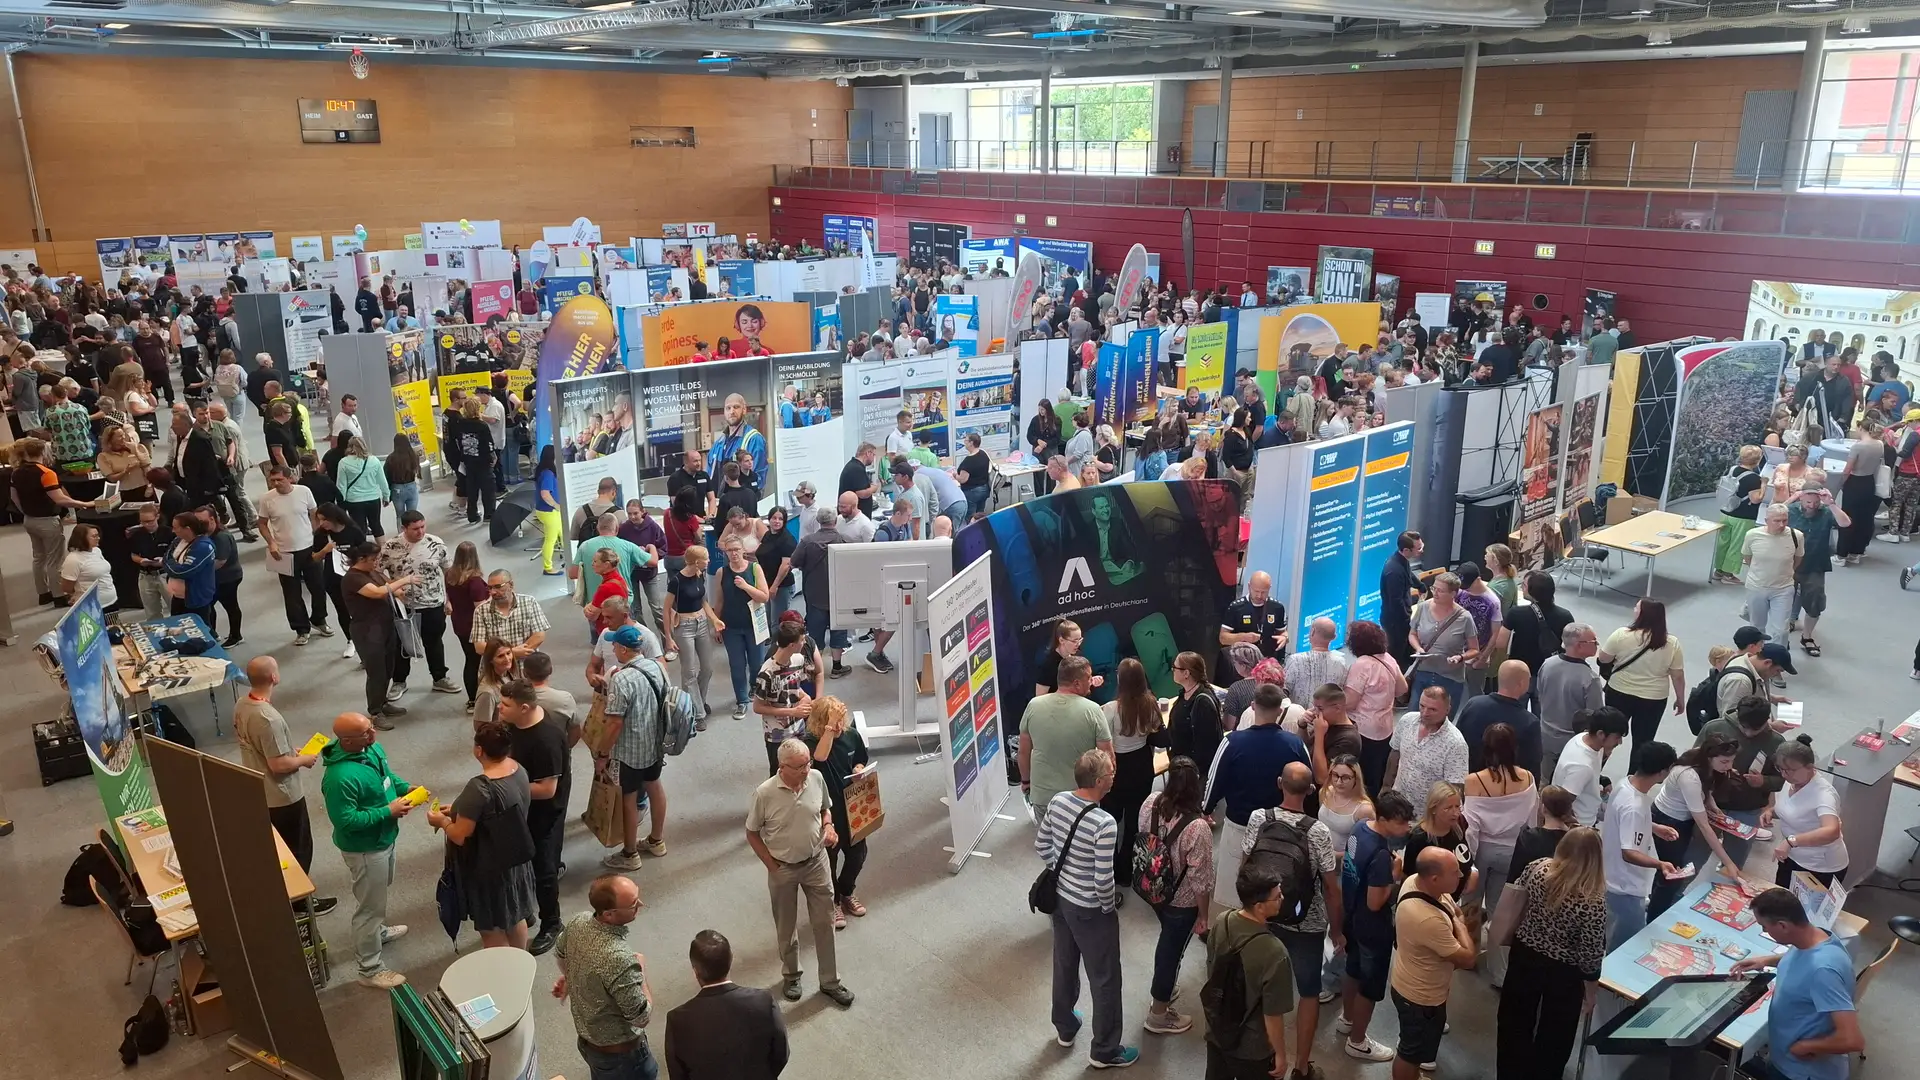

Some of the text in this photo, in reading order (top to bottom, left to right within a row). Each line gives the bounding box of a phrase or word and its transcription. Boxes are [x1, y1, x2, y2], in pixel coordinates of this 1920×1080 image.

[326, 100, 355, 111] 10:47
[693, 225, 709, 234] TFT
[993, 239, 1009, 247] AWA
[1325, 260, 1363, 273] SCHON IN
[1324, 271, 1361, 297] UNI-
[569, 332, 593, 369] HIER
[796, 362, 831, 371] AUSBILDUNG
[1143, 335, 1152, 403] #KÖNNENLERNEN
[563, 387, 608, 399] DEINE BENEFITS
[643, 381, 702, 395] WERDE TEIL DES
[957, 382, 974, 390] DEINE
[1108, 352, 1119, 424] #KÖNNENLERNEN
[644, 390, 717, 406] #VOESTALPINETEAM
[644, 403, 696, 417] IN SCHMÖLLN
[1101, 396, 1109, 422] JETZT
[1058, 589, 1096, 605] ad hoc
[1110, 598, 1148, 609] Deutschland
[1634, 831, 1643, 846] 19
